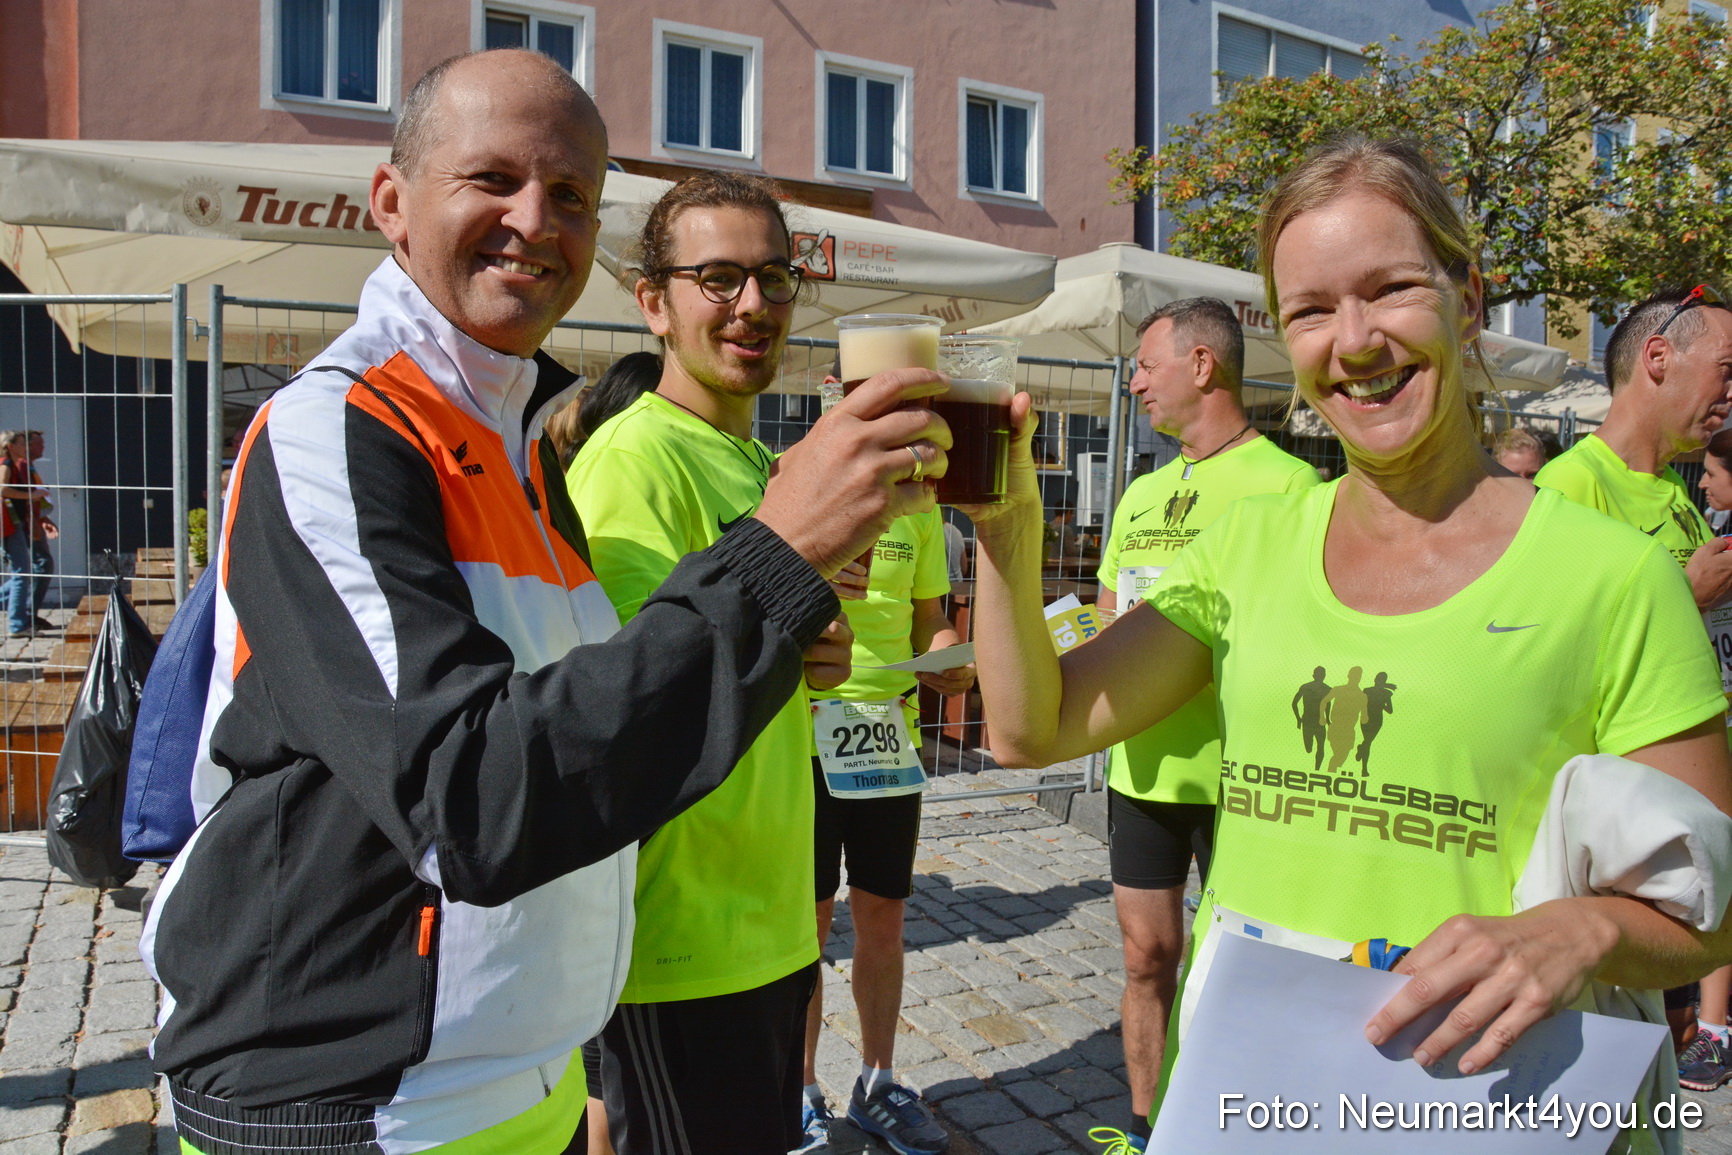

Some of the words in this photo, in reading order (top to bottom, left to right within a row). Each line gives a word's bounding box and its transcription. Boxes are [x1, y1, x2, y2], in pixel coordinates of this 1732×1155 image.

[843, 240, 897, 262] PEPE
[843, 273, 899, 286] RESTAURANT
[1234, 299, 1278, 330] Tuc
[844, 704, 888, 716] BOCK
[832, 722, 900, 758] 2298
[844, 760, 867, 769] PARTL
[853, 775, 899, 787] Thomas
[656, 955, 692, 965] DRI-FIT
